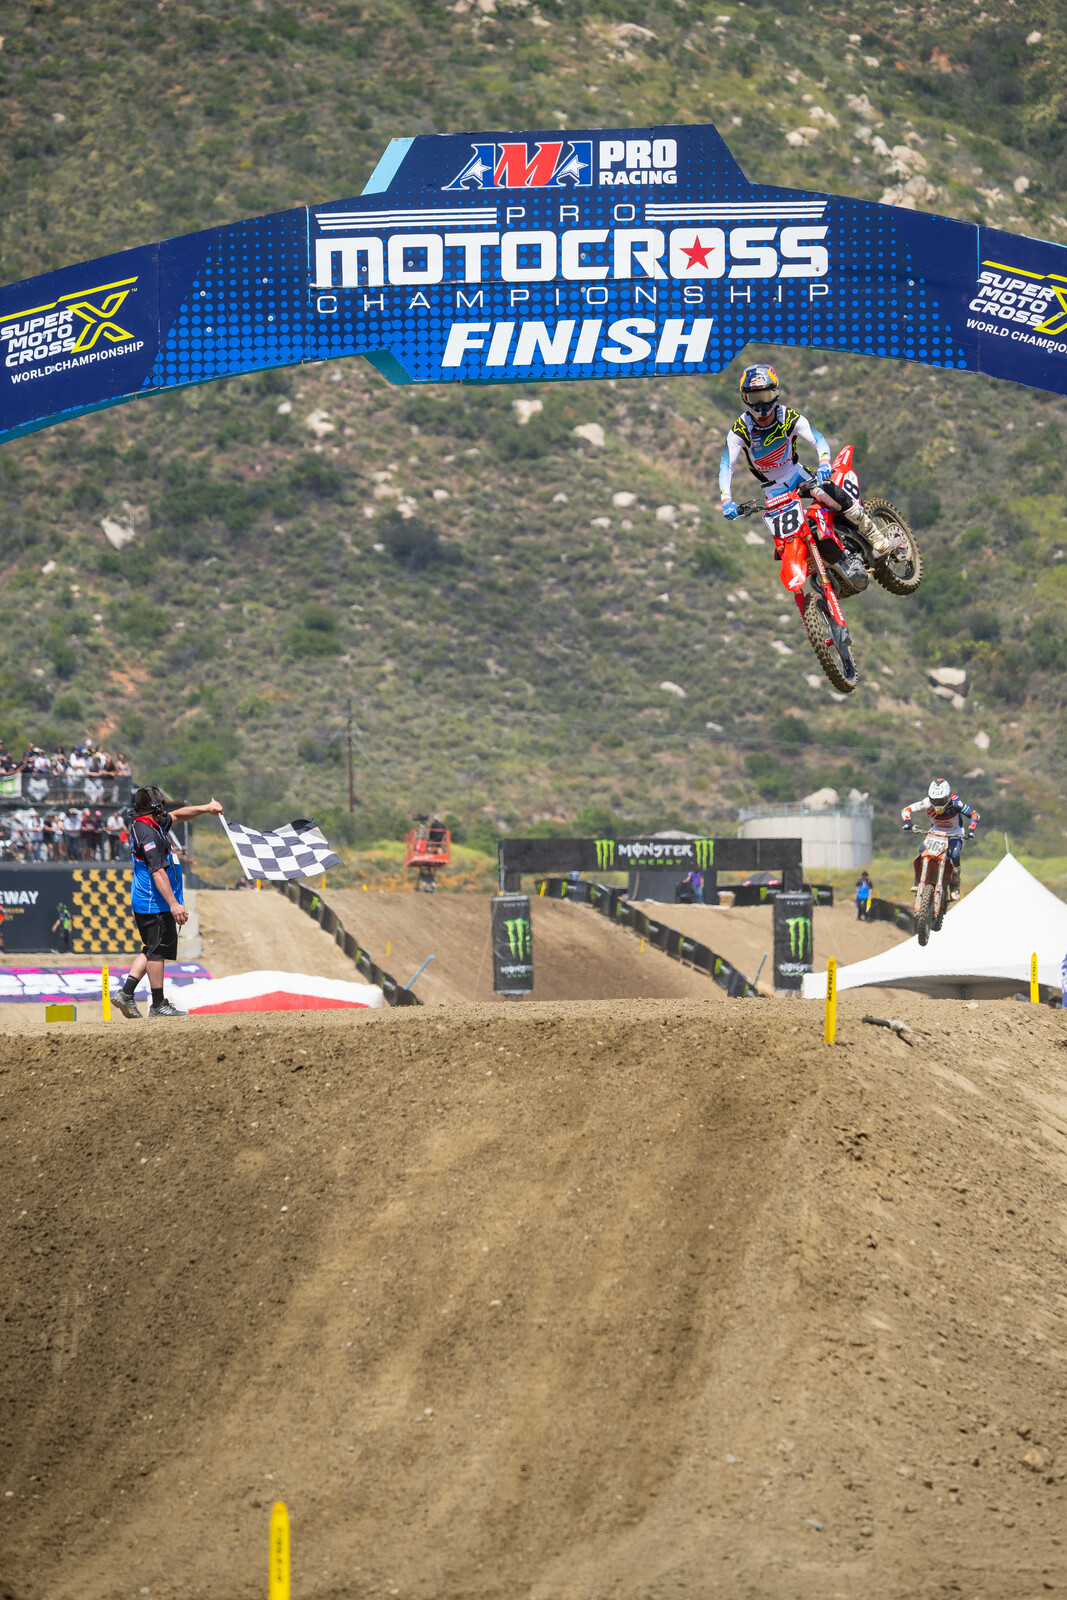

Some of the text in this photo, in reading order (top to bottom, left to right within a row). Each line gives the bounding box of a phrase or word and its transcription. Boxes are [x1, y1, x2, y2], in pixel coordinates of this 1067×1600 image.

[441, 139, 677, 190] AMA PRO
[600, 170, 677, 185] RACING
[506, 204, 636, 224] PRO
[315, 226, 829, 287] MOTOCROSS
[316, 284, 829, 313] CHAMPIONSHIP
[976, 271, 1056, 301] SUPER
[977, 286, 1048, 313] MOTO
[0, 310, 74, 340] SUPER
[968, 299, 1046, 327] CROSS
[8, 324, 72, 353] MOTO
[441, 318, 714, 367] FINISH
[966, 319, 1067, 354] WORLD CHAMPIO
[5, 337, 76, 367] CROSS
[11, 341, 144, 384] WORLD CHAMPIONSHIP
[757, 459, 791, 471] HONDA
[772, 509, 799, 538] 18
[618, 842, 694, 858] MONSTER
